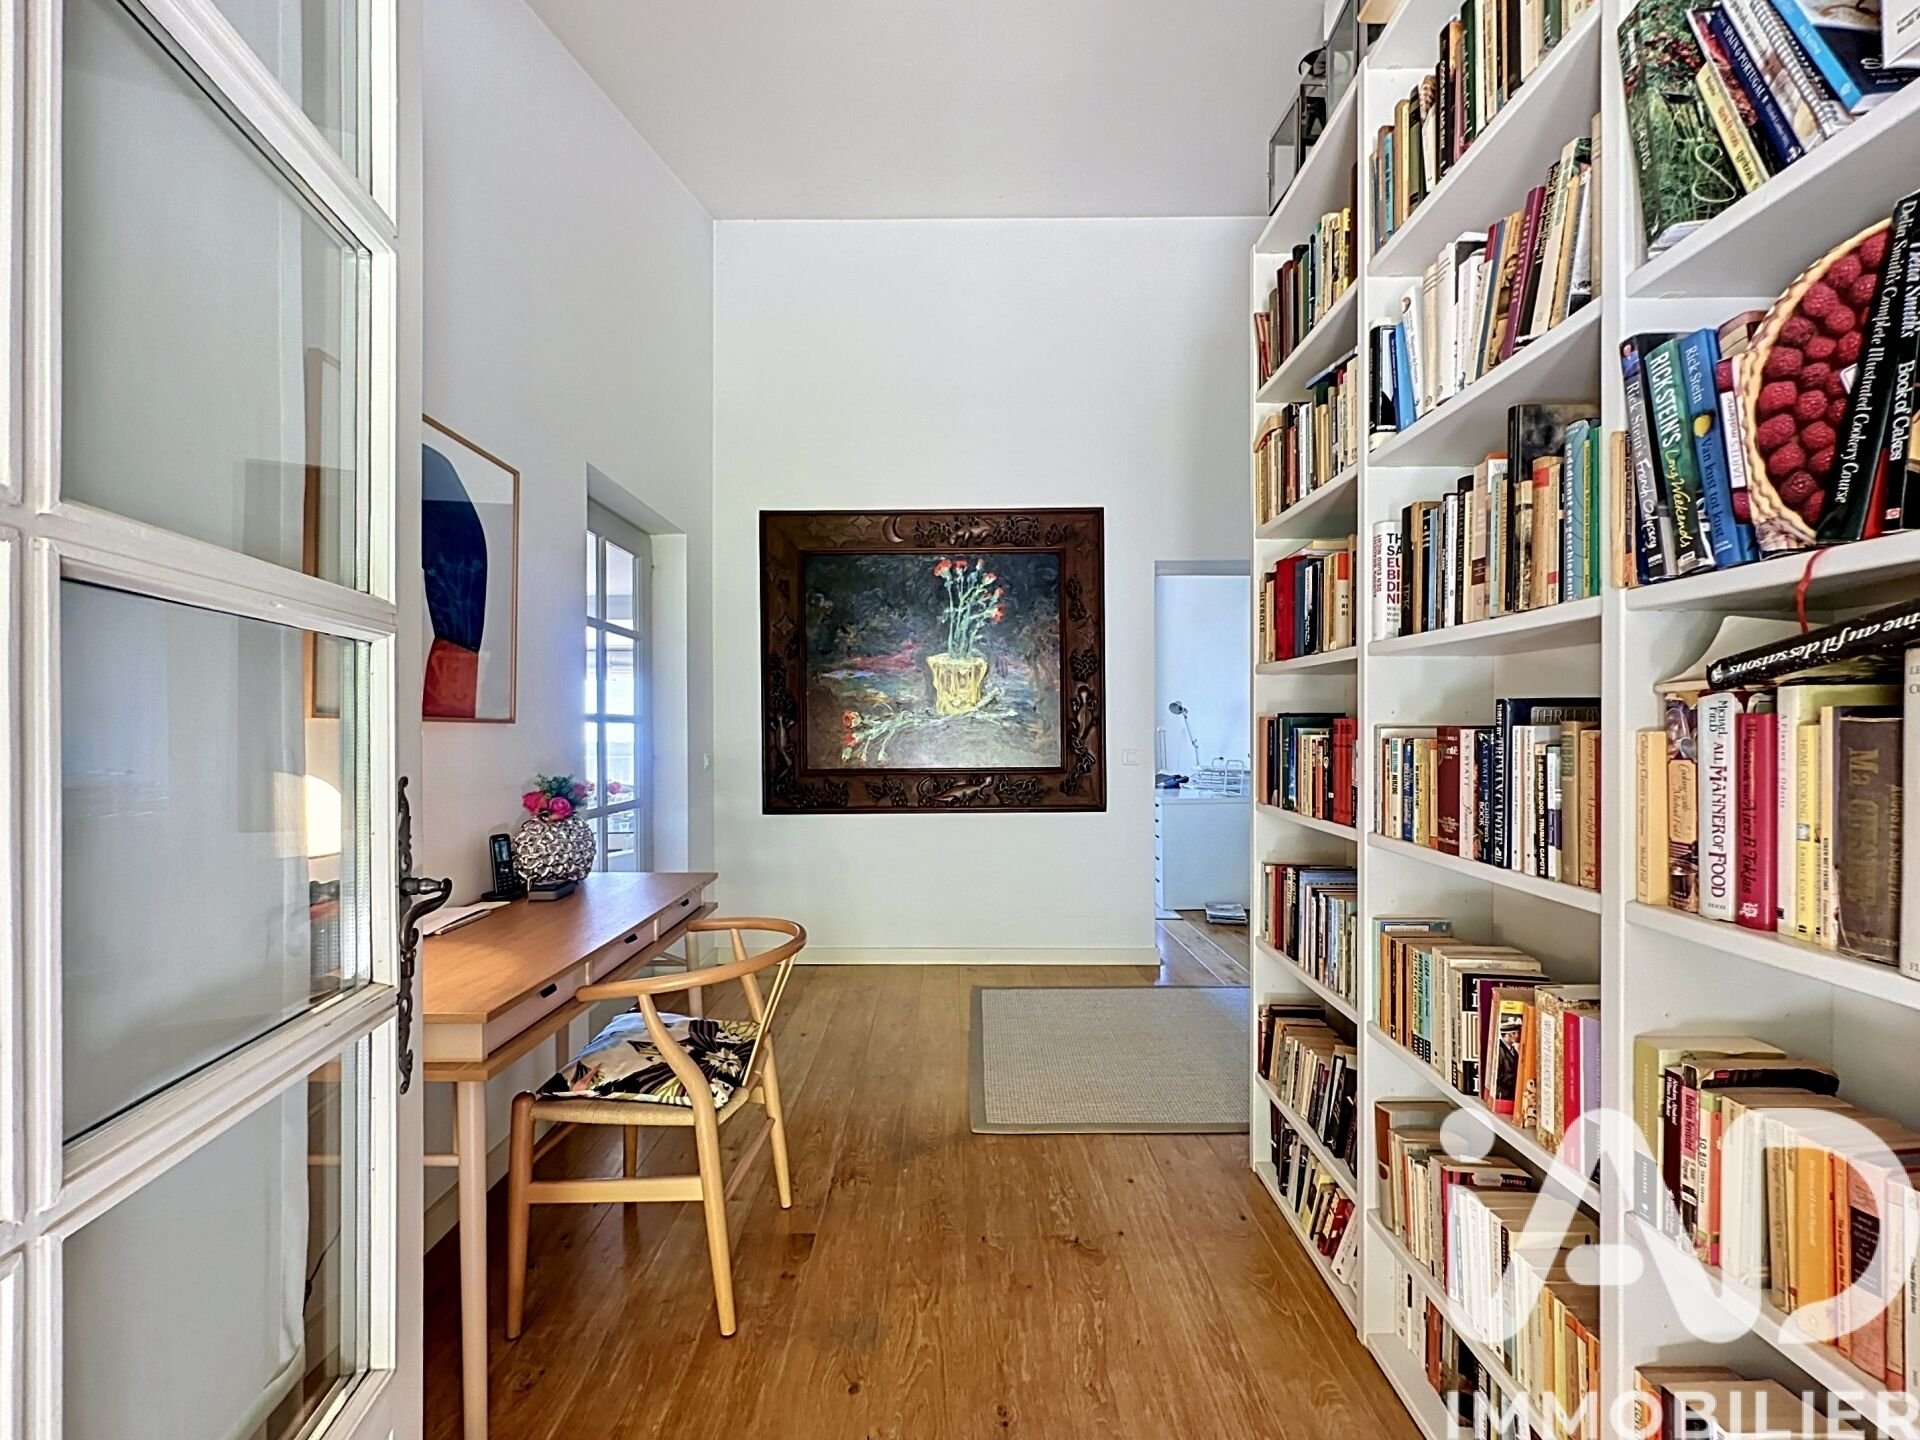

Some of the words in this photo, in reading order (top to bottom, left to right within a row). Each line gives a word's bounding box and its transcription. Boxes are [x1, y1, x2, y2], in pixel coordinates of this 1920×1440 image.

[1722, 26, 1742, 54] SPAIN
[1739, 56, 1766, 101] PORTUGAL
[1895, 201, 1916, 238] Delia
[1516, 215, 1532, 267] HEMELSE
[1883, 240, 1908, 286] Smith's
[1511, 268, 1521, 304] VREDE
[1869, 287, 1897, 344] Complete
[1650, 352, 1671, 392] RICK
[1685, 345, 1701, 373] Rick
[1691, 373, 1706, 405] Stein
[1856, 347, 1885, 410] Illustrated
[1895, 362, 1914, 399] Book
[1627, 381, 1644, 410] Rick
[1894, 399, 1911, 414] of
[1655, 390, 1681, 449] STEIN'S
[1632, 414, 1647, 459] Stein's
[1700, 437, 1713, 461] Van
[1843, 413, 1870, 461] Cookery
[1890, 416, 1908, 461] Cakes
[1566, 442, 1575, 506] godsdienst
[1662, 449, 1679, 480] Long
[1731, 440, 1744, 478] TARTES
[1635, 459, 1654, 499] French
[1704, 464, 1718, 491] kust
[1834, 462, 1859, 504] Course
[1566, 509, 1574, 523] en
[1670, 479, 1693, 548] Weekends
[1709, 492, 1720, 509] tot
[1640, 499, 1658, 550] Odyssey
[1712, 511, 1725, 539] kust
[1565, 526, 1574, 601] geschiedenis
[1821, 626, 1851, 653] fil
[1847, 623, 1881, 642] au
[1728, 650, 1790, 675] saisons
[1788, 640, 1820, 660] des
[1534, 709, 1580, 723] THREE
[1708, 705, 1719, 732] FIELD
[1716, 700, 1728, 738] MICHAEL
[1586, 736, 1595, 759] Joyce
[1638, 734, 1649, 767] Culinary
[1713, 742, 1724, 764] ALL
[1799, 738, 1808, 769] HOME
[1494, 738, 1506, 798] TRUMAN
[1538, 763, 1545, 772] IN
[1586, 759, 1595, 780] Cary
[1638, 768, 1649, 796] Classics
[1847, 748, 1879, 786] Ma
[1673, 788, 1683, 817] Michael
[1709, 765, 1728, 834] MANNER
[1780, 777, 1788, 809] Odette
[1799, 769, 1808, 819] COOKING
[1494, 797, 1506, 846] CAPOTE
[1587, 805, 1595, 833] Fearful
[1742, 800, 1758, 835] Alice
[1886, 783, 1903, 840] AUGUSTE
[1586, 833, 1594, 849] Joy
[1672, 818, 1684, 839] Field
[1711, 836, 1724, 851] OF
[1708, 851, 1727, 898] FOOD
[1741, 851, 1758, 893] Toklas
[1799, 846, 1808, 874] LAURIE
[1799, 879, 1808, 912] COLWIN
[1684, 1094, 1695, 1121] Babylon
[1684, 1121, 1696, 1151] Revisited
[1698, 1137, 1708, 1151] SO
[1698, 1151, 1707, 1168] BIG
